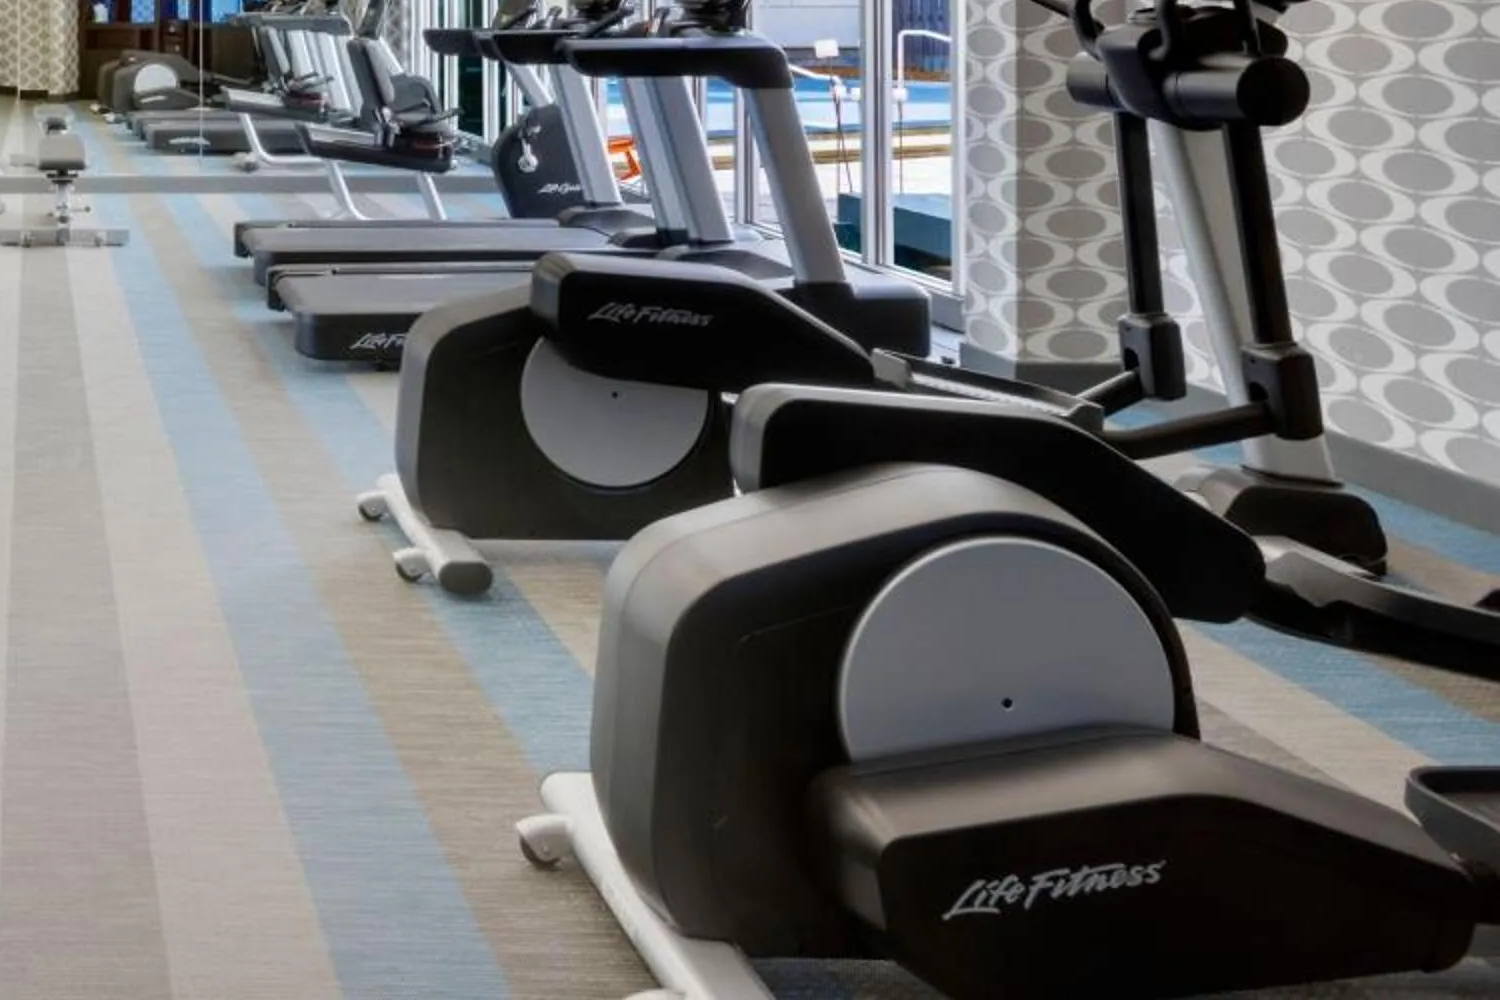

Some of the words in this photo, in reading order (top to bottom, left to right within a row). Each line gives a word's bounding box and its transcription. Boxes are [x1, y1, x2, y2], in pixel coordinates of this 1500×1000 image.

[586, 301, 637, 323] Life
[632, 305, 715, 327] Fitness
[942, 873, 1026, 921] Life
[1023, 860, 1167, 910] Fitness
